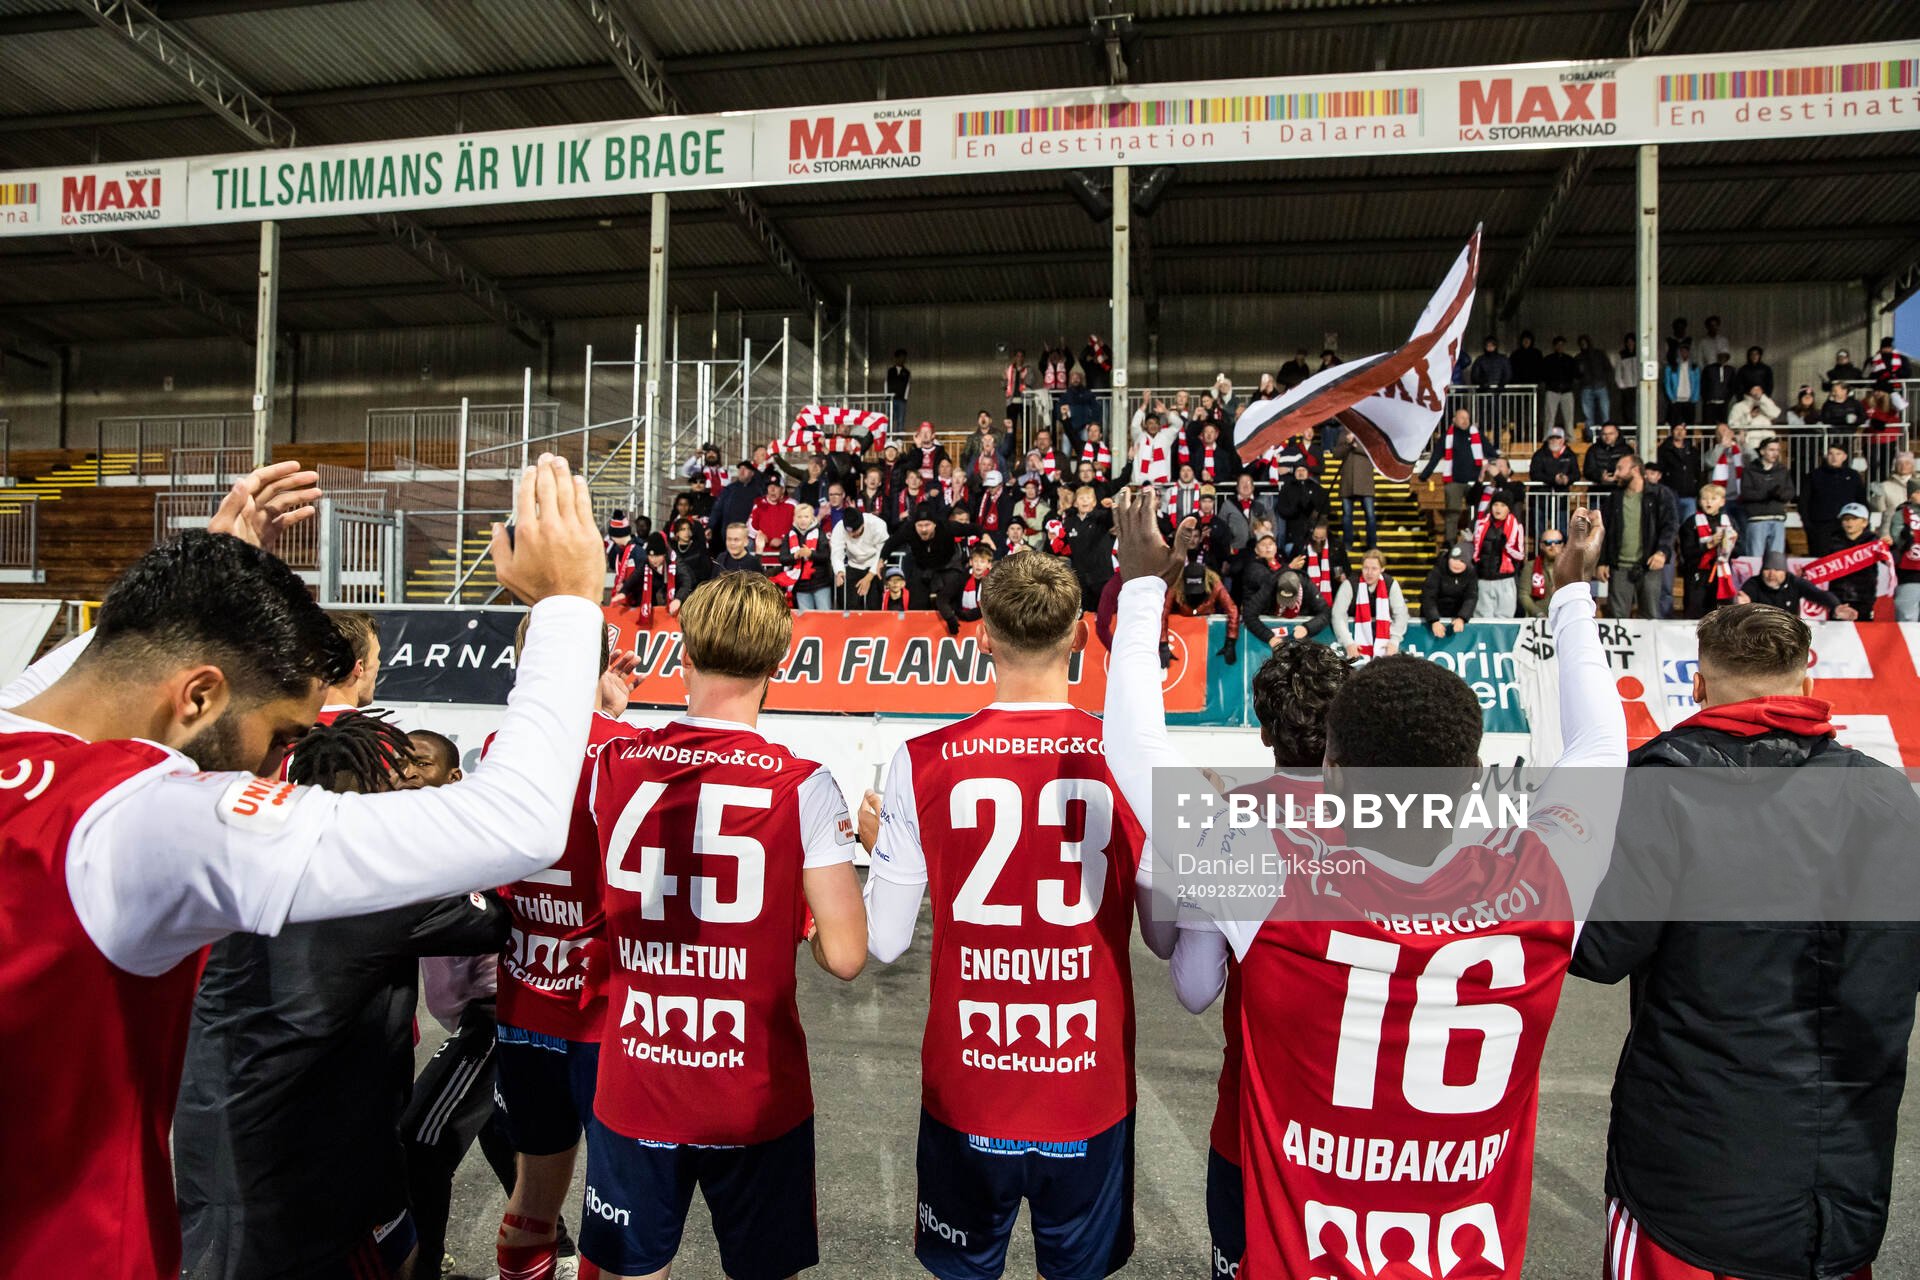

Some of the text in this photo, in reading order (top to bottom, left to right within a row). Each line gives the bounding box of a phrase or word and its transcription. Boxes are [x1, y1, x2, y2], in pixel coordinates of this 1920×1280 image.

[1560, 70, 1616, 82] BORLÄNGE
[874, 108, 922, 119] BORLÄNGE
[1459, 79, 1617, 125] MAXI
[1670, 106, 1705, 126] En
[788, 116, 921, 161] MAXI
[965, 121, 1407, 158] En destination i Dalarna
[1459, 123, 1616, 141] ICA STORMARKNAD
[212, 128, 725, 210] TILLSAMMANS ÄR VI IK BRAGE
[788, 155, 921, 175] ICA STORMARKNAD
[62, 175, 161, 213] MAXI
[61, 209, 161, 225] ICA STORMARKNAD
[606, 780, 773, 924] 45
[948, 777, 1114, 927] 23
[514, 893, 583, 927] THÖRN
[618, 936, 747, 980] HARLETUN
[960, 945, 1093, 985] ENGQVIST
[1325, 930, 1526, 1114] 16
[961, 1047, 1097, 1074] clockwork
[1282, 1119, 1510, 1183] ABUBAKARI
